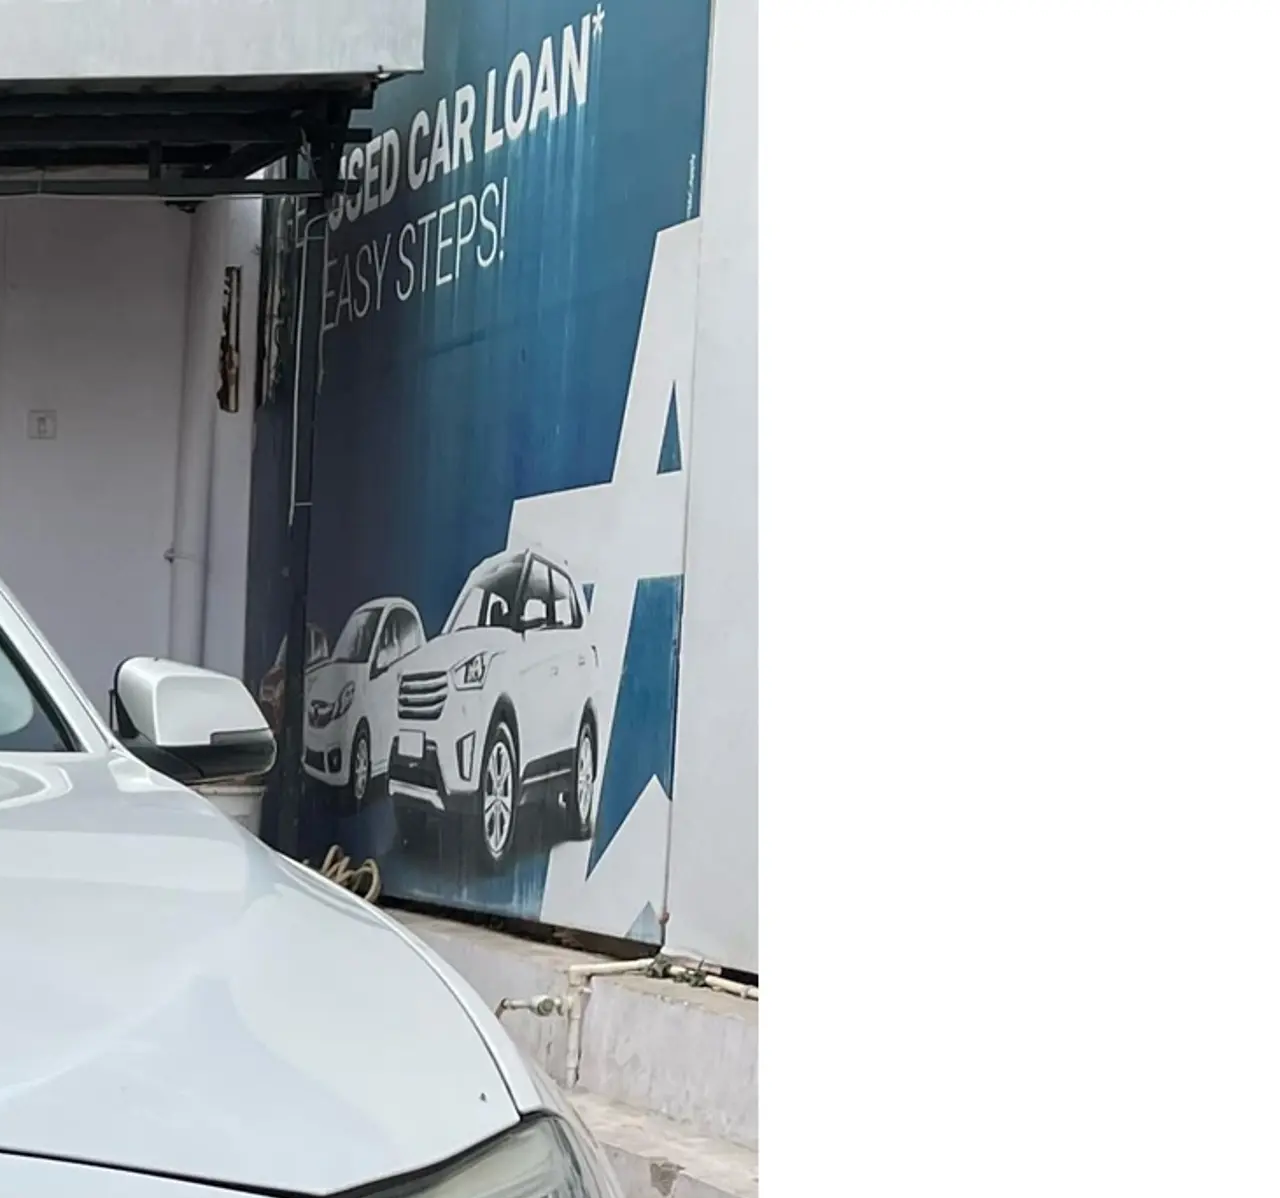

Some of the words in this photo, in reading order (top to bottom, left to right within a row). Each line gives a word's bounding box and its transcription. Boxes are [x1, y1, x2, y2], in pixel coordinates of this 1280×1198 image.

[408, 84, 475, 190] CAR
[321, 234, 390, 332] EASY
[396, 177, 508, 301] STEPS!
